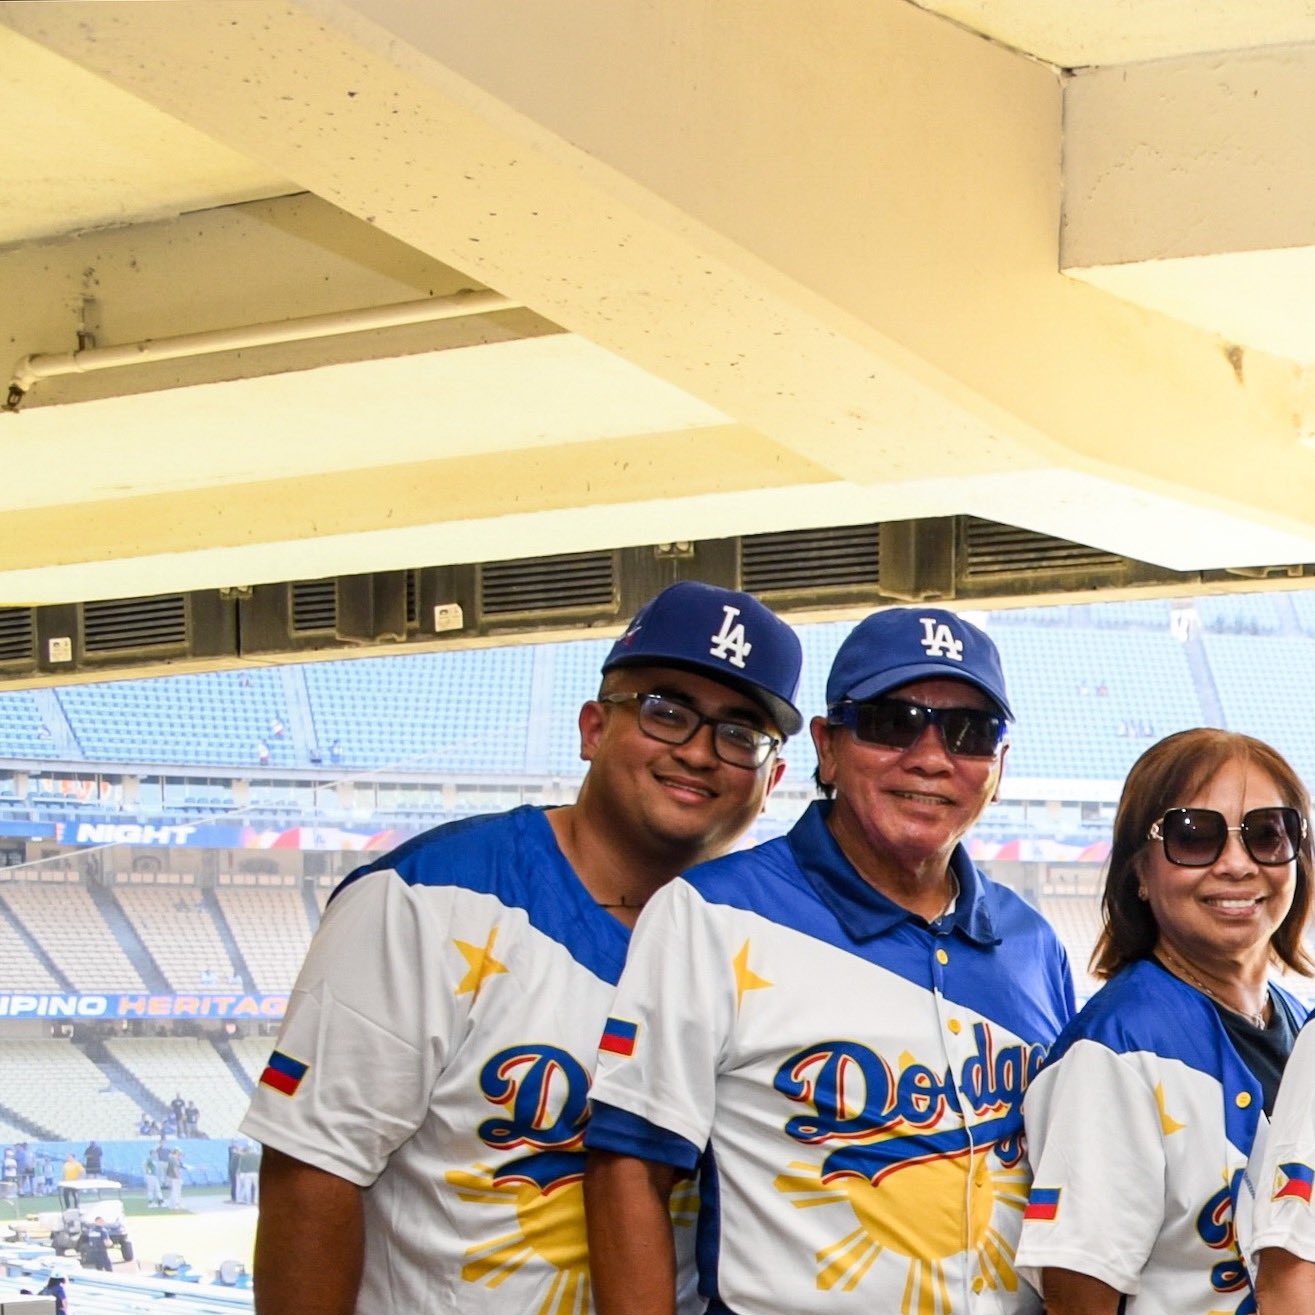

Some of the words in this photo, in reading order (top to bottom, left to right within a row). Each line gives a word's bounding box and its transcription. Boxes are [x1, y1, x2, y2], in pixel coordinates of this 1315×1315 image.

[710, 605, 752, 668] LA
[919, 617, 963, 661] LA
[77, 823, 197, 845] NIGHT
